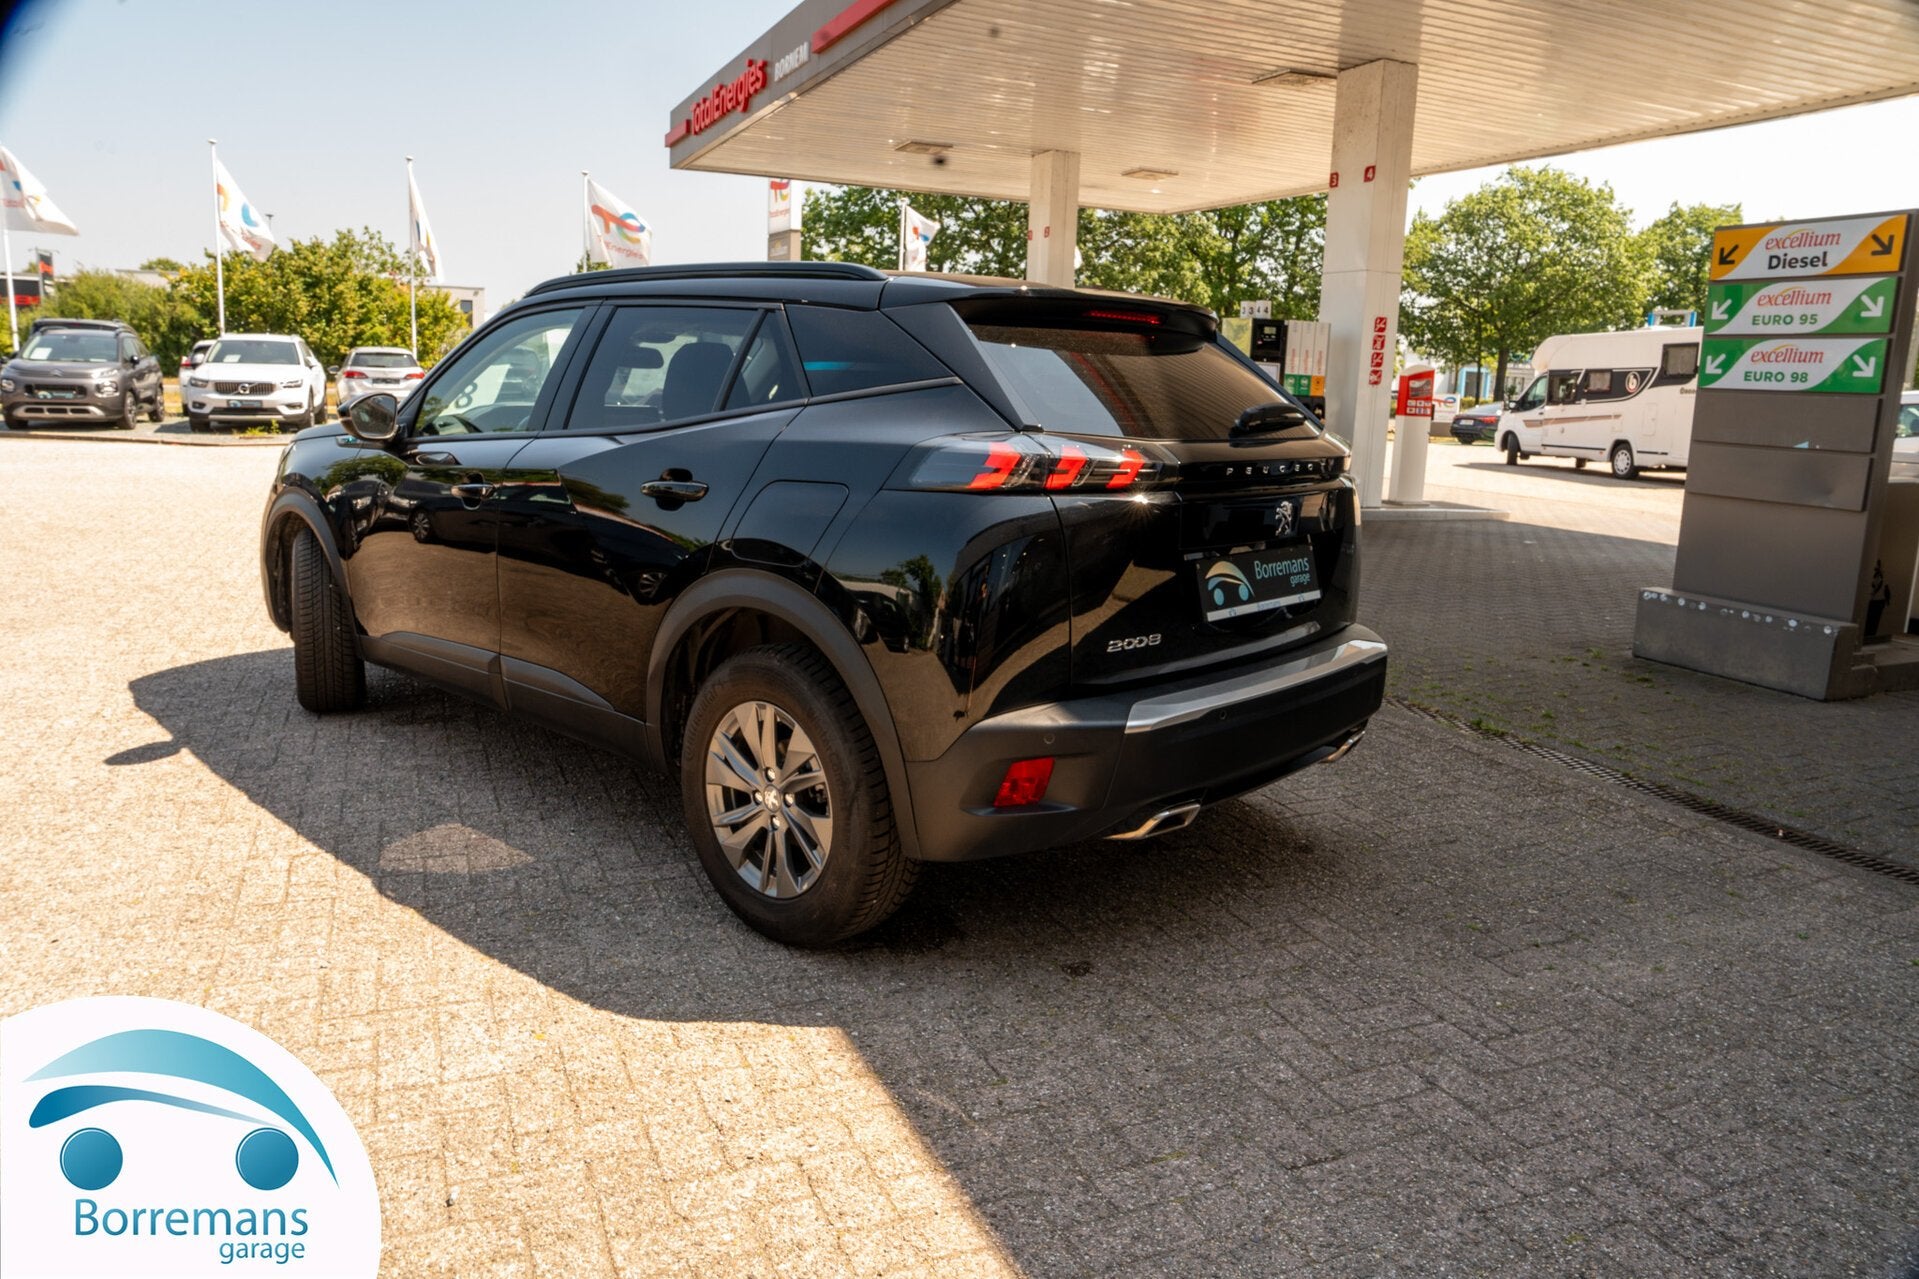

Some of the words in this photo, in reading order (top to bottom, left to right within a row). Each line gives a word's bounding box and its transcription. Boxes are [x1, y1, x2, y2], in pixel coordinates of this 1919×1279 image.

[690, 58, 768, 135] TotalEnergies
[774, 41, 810, 82] BORNEM
[1765, 230, 1841, 250] excellium
[1767, 251, 1829, 270] Diesel
[1757, 289, 1832, 307] excellium
[1751, 314, 1794, 326] EURO
[1799, 314, 1818, 325] 95
[1750, 347, 1824, 364] excellium
[1743, 371, 1785, 382] EURO
[1790, 372, 1809, 383] 98
[1254, 558, 1310, 580] Borremans
[1289, 572, 1311, 588] garage
[1107, 633, 1162, 652] 2008
